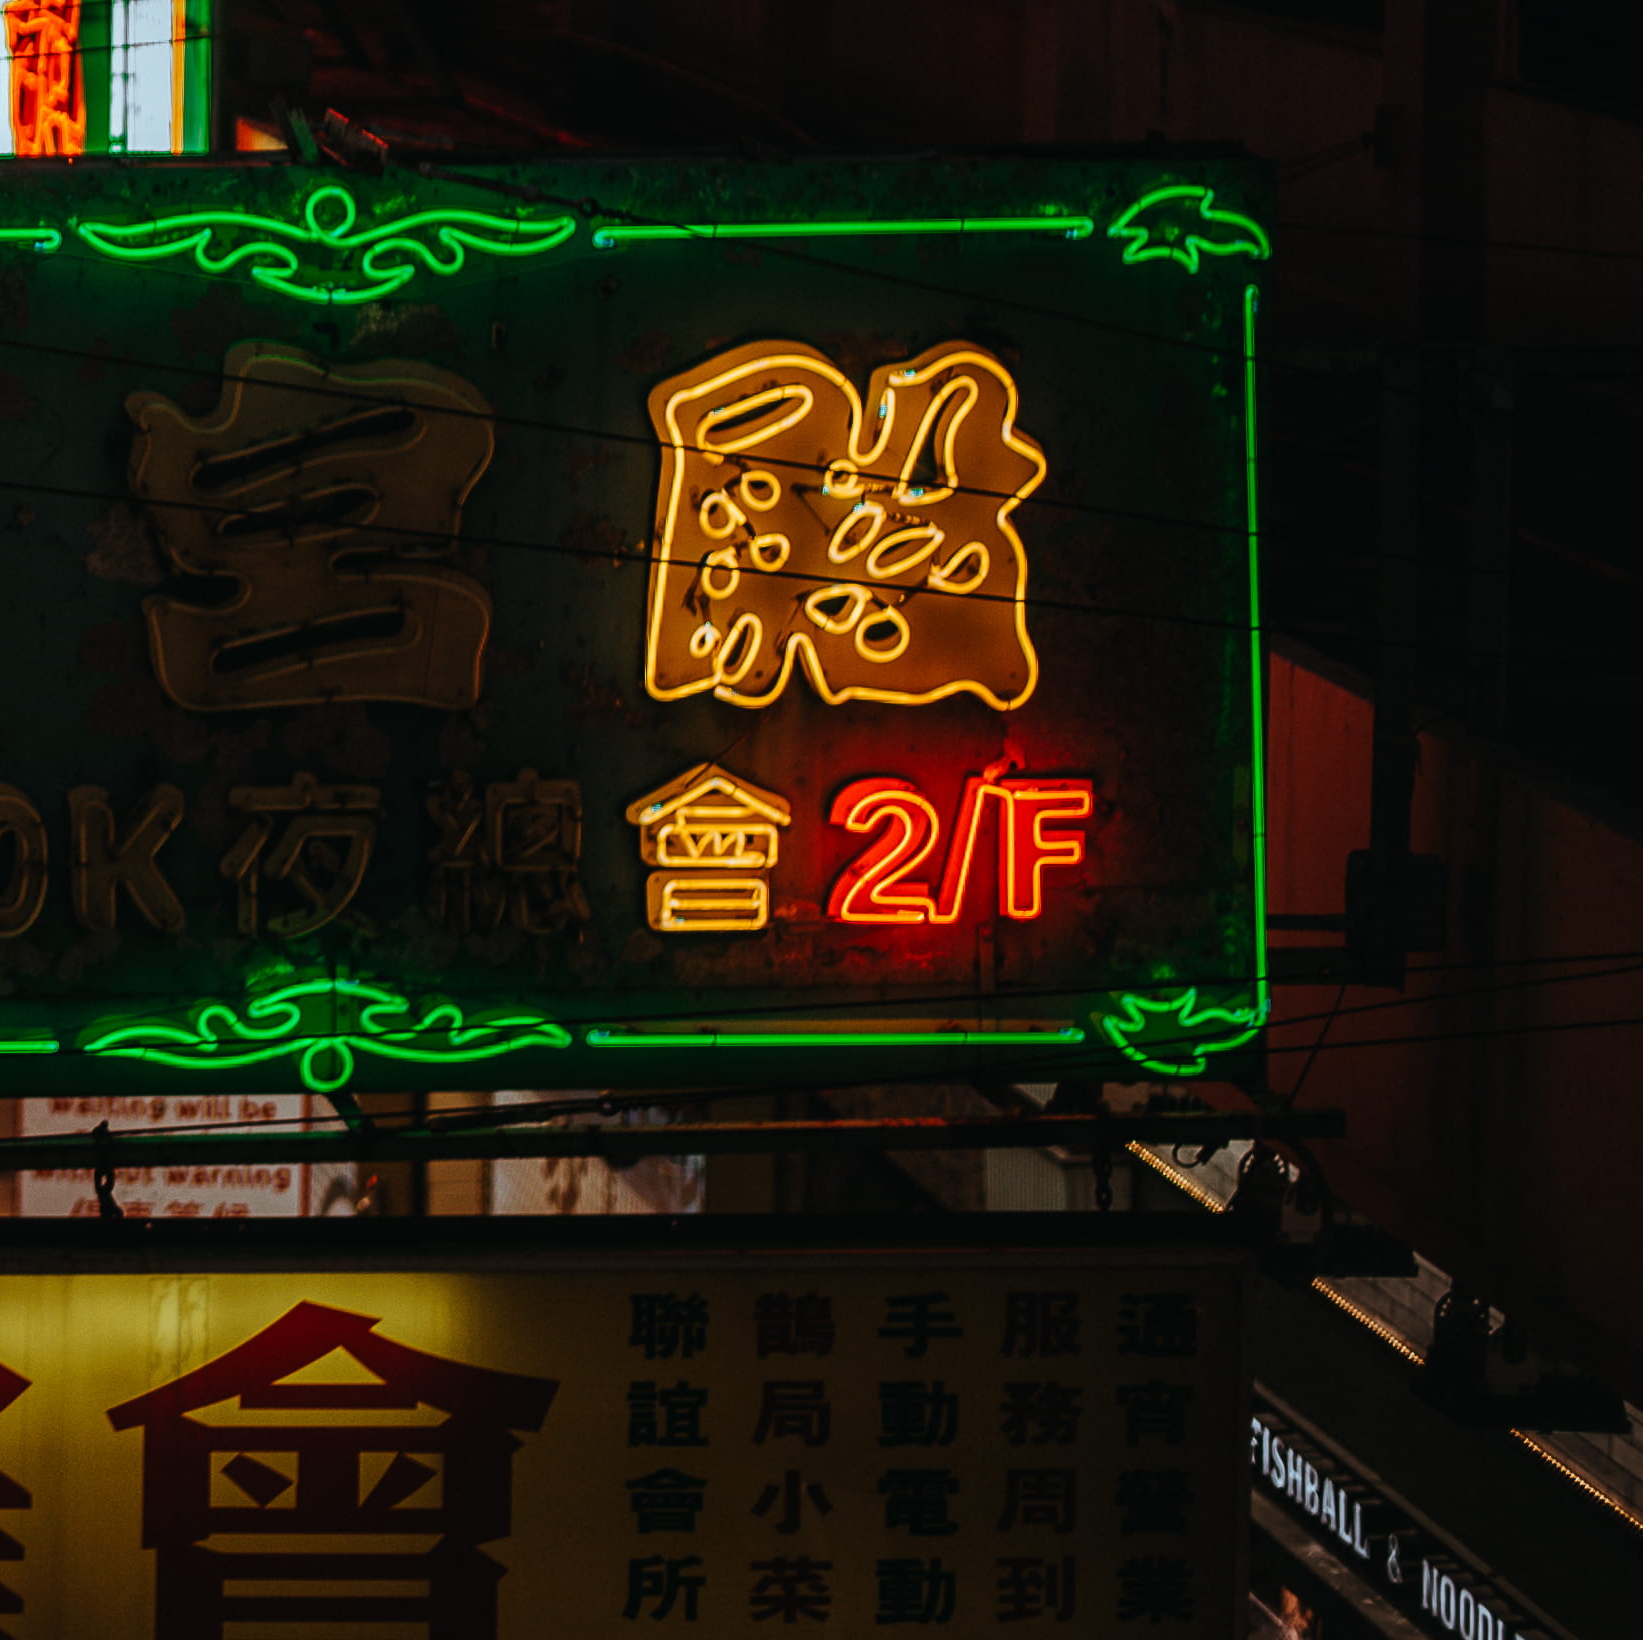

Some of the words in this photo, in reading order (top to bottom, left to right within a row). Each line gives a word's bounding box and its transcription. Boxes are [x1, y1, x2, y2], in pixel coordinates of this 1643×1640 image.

[826, 775, 1094, 926] 2/F
[622, 1291, 710, 1622] 聯誼會所
[875, 1291, 965, 1625] 手動電動
[996, 1290, 1083, 1623] 服務周到
[1115, 1291, 1198, 1623] 通宵營業
[1251, 1416, 1370, 1559] FISHBALL
